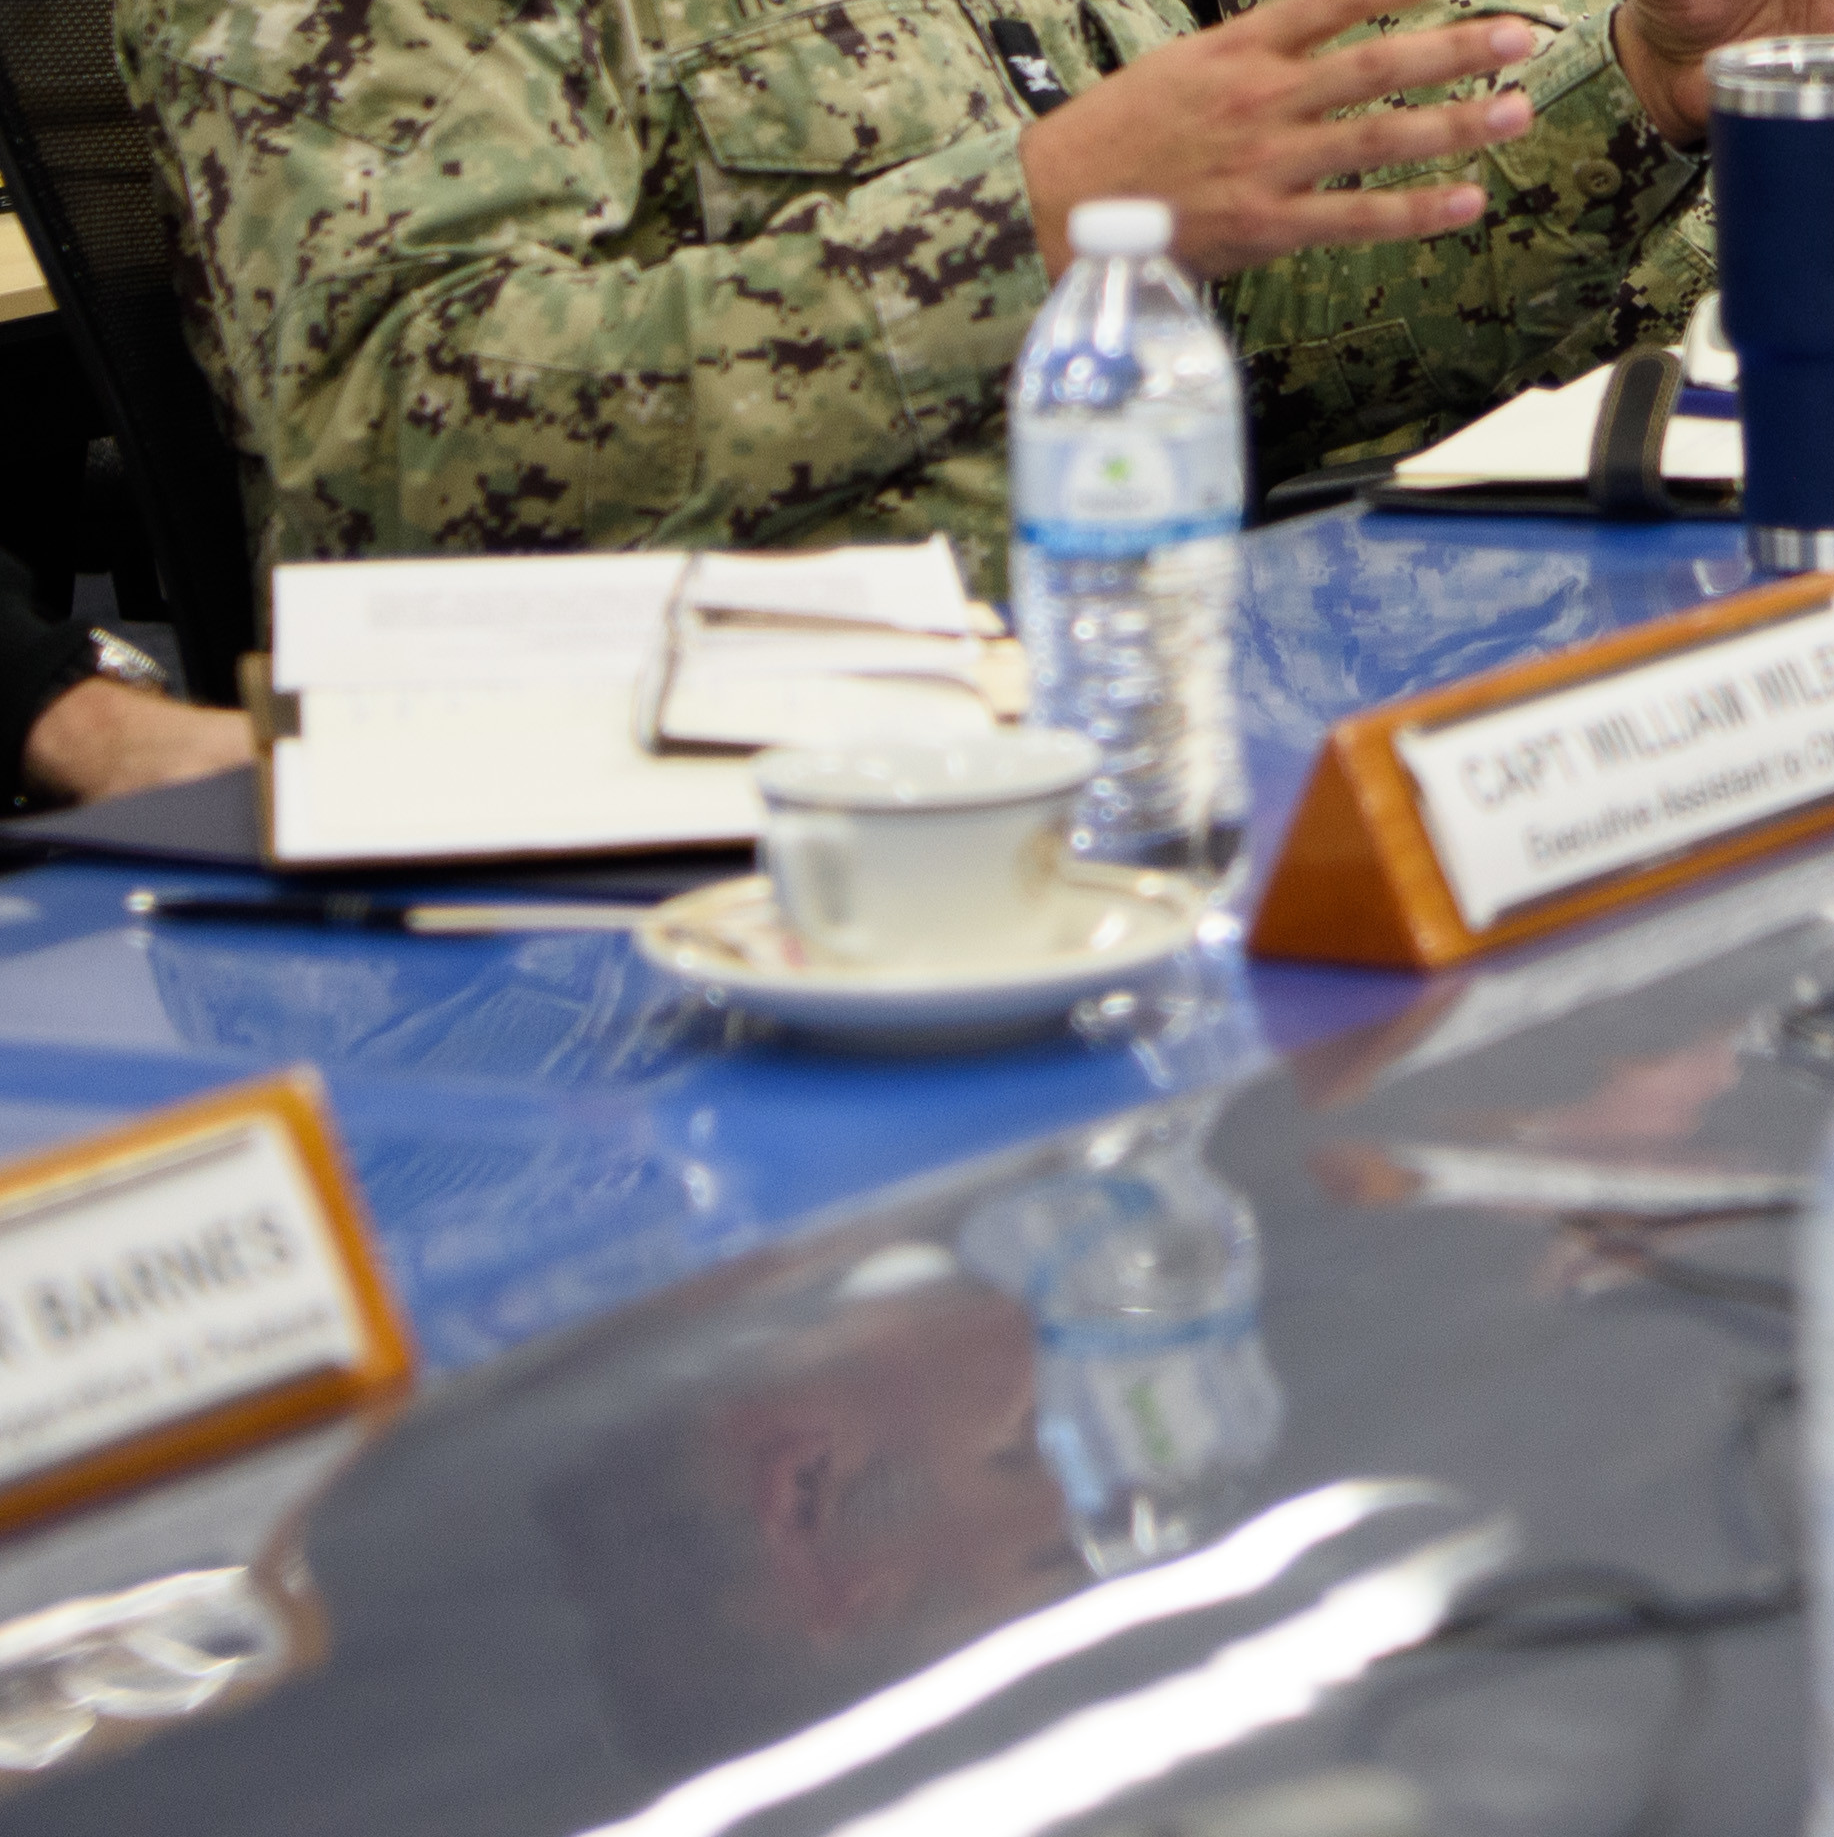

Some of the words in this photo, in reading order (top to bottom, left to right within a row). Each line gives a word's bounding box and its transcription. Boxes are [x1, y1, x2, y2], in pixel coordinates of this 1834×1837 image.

[1461, 726, 1579, 811] CAPT
[1583, 678, 1750, 766] WILLIAM
[26, 1206, 296, 1354] BARNES
